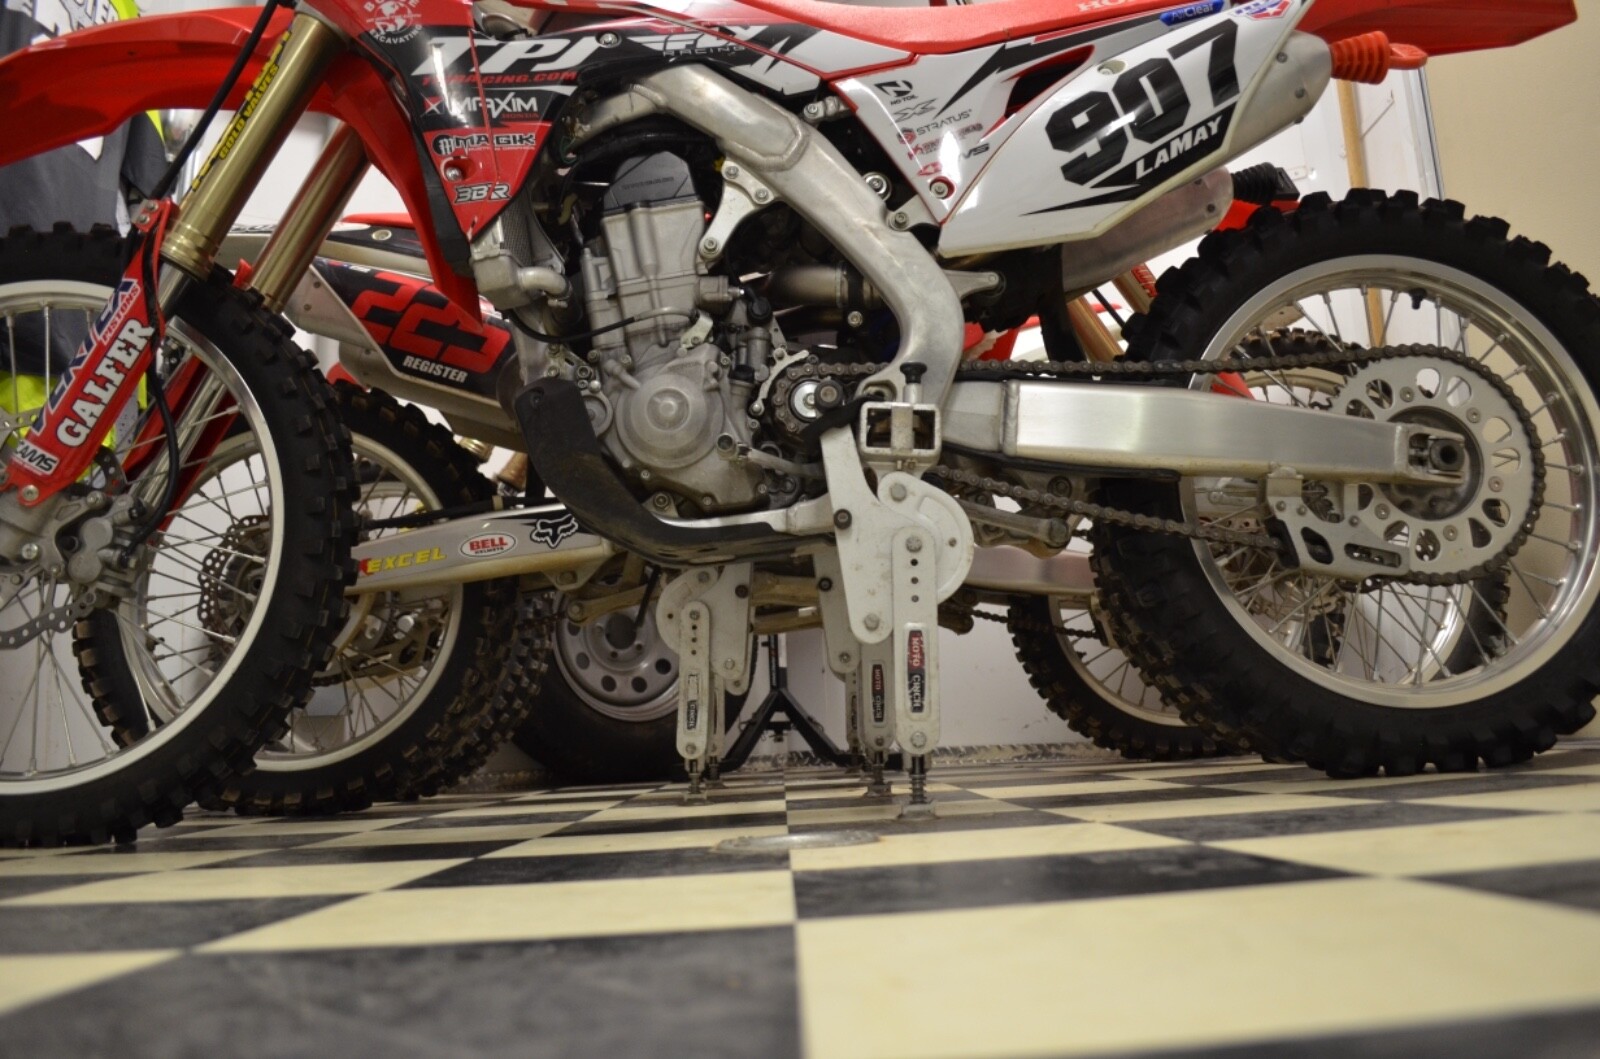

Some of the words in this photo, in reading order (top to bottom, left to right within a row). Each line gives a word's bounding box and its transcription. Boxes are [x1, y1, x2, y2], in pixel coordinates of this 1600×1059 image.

[411, 36, 600, 76] TPJ
[663, 45, 745, 57] RACING
[1045, 19, 1239, 186] 907
[453, 132, 537, 154] MAGIK
[1136, 115, 1222, 179] LAMAY
[102, 285, 140, 343] PISTONS
[57, 319, 154, 447] GALFER
[403, 355, 468, 383] REGISTER
[470, 536, 508, 551] BELL
[367, 547, 447, 574] EXCEL
[911, 636, 920, 667] MOTO
[912, 674, 921, 707] CINCH
